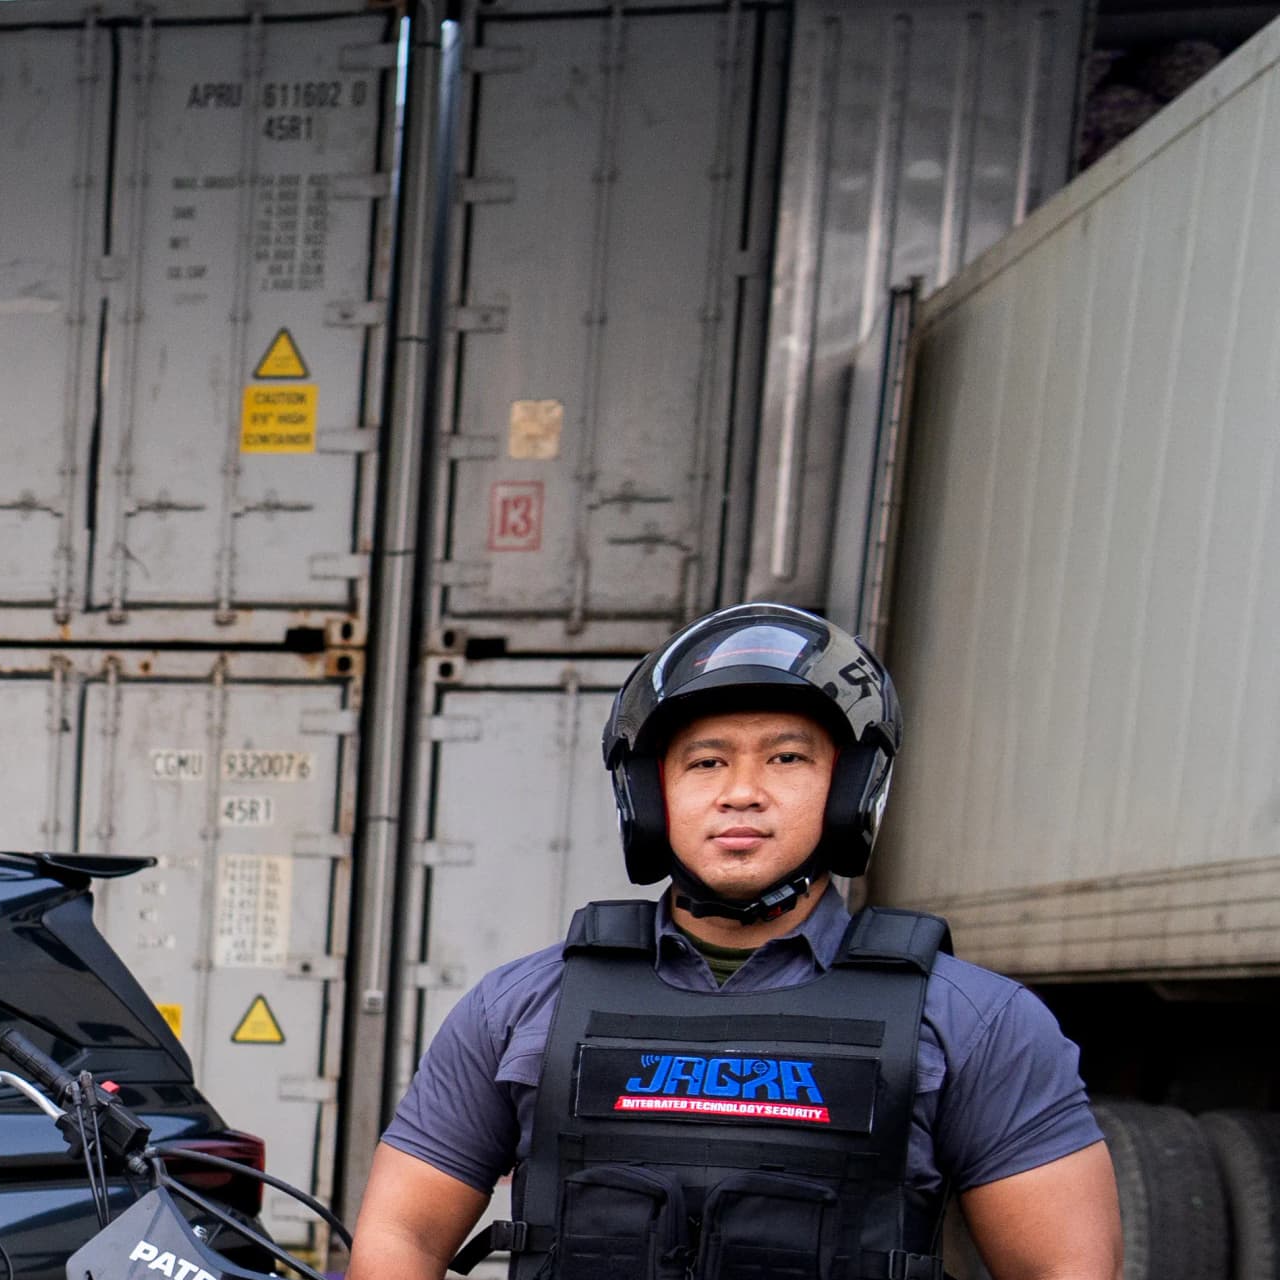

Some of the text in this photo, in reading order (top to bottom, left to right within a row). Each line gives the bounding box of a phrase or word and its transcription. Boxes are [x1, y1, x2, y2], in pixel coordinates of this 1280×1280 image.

[499, 495, 532, 538] 13
[622, 1098, 823, 1119] INTEGRATED TECHNOLOGY SECURITY
